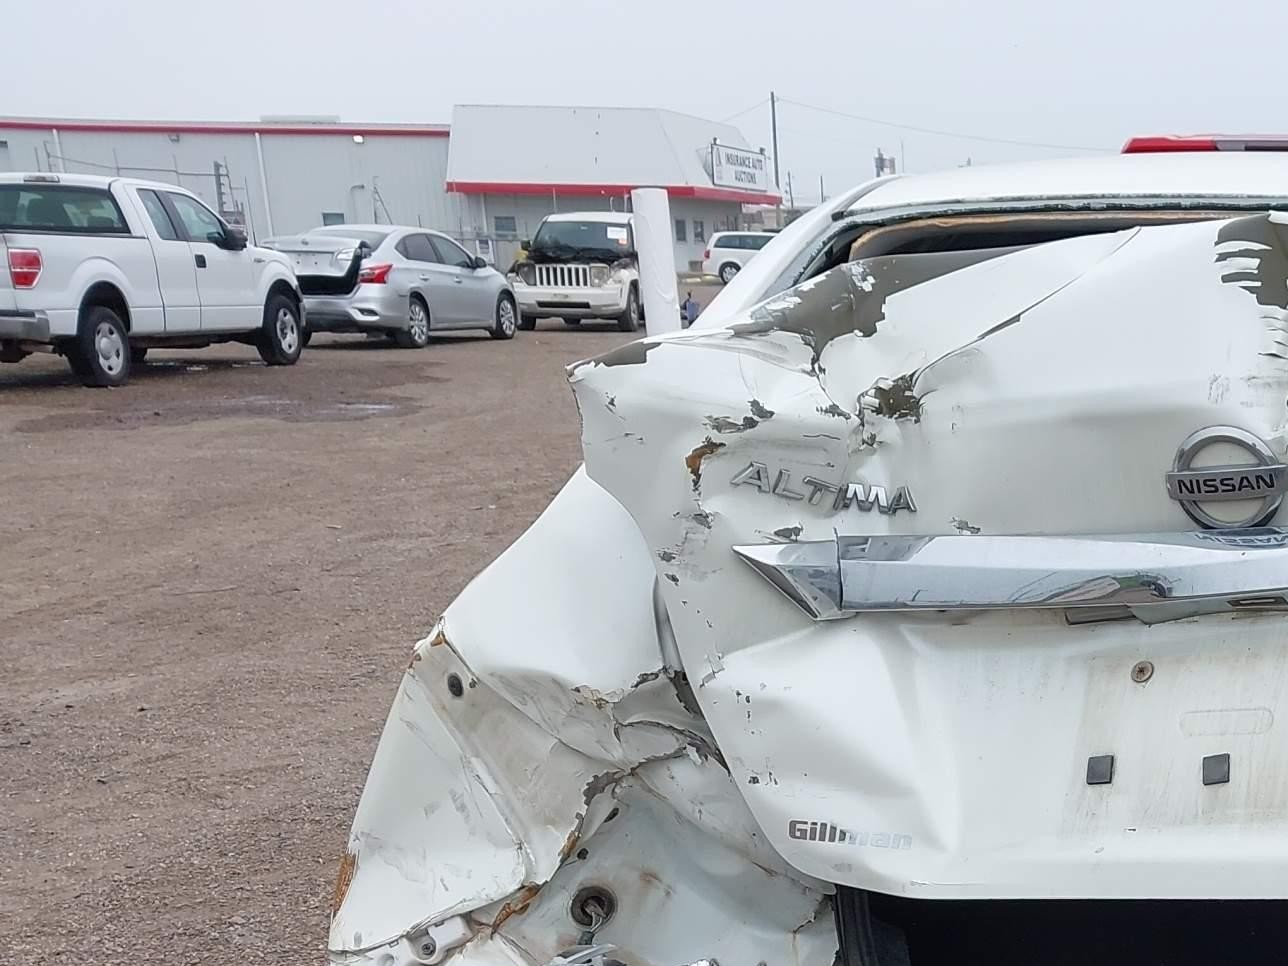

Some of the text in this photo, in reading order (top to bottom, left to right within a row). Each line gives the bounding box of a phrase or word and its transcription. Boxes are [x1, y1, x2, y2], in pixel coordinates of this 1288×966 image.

[730, 461, 917, 515] ALTIMA
[1177, 473, 1275, 494] NISSAN
[788, 819, 913, 849] Gillman
